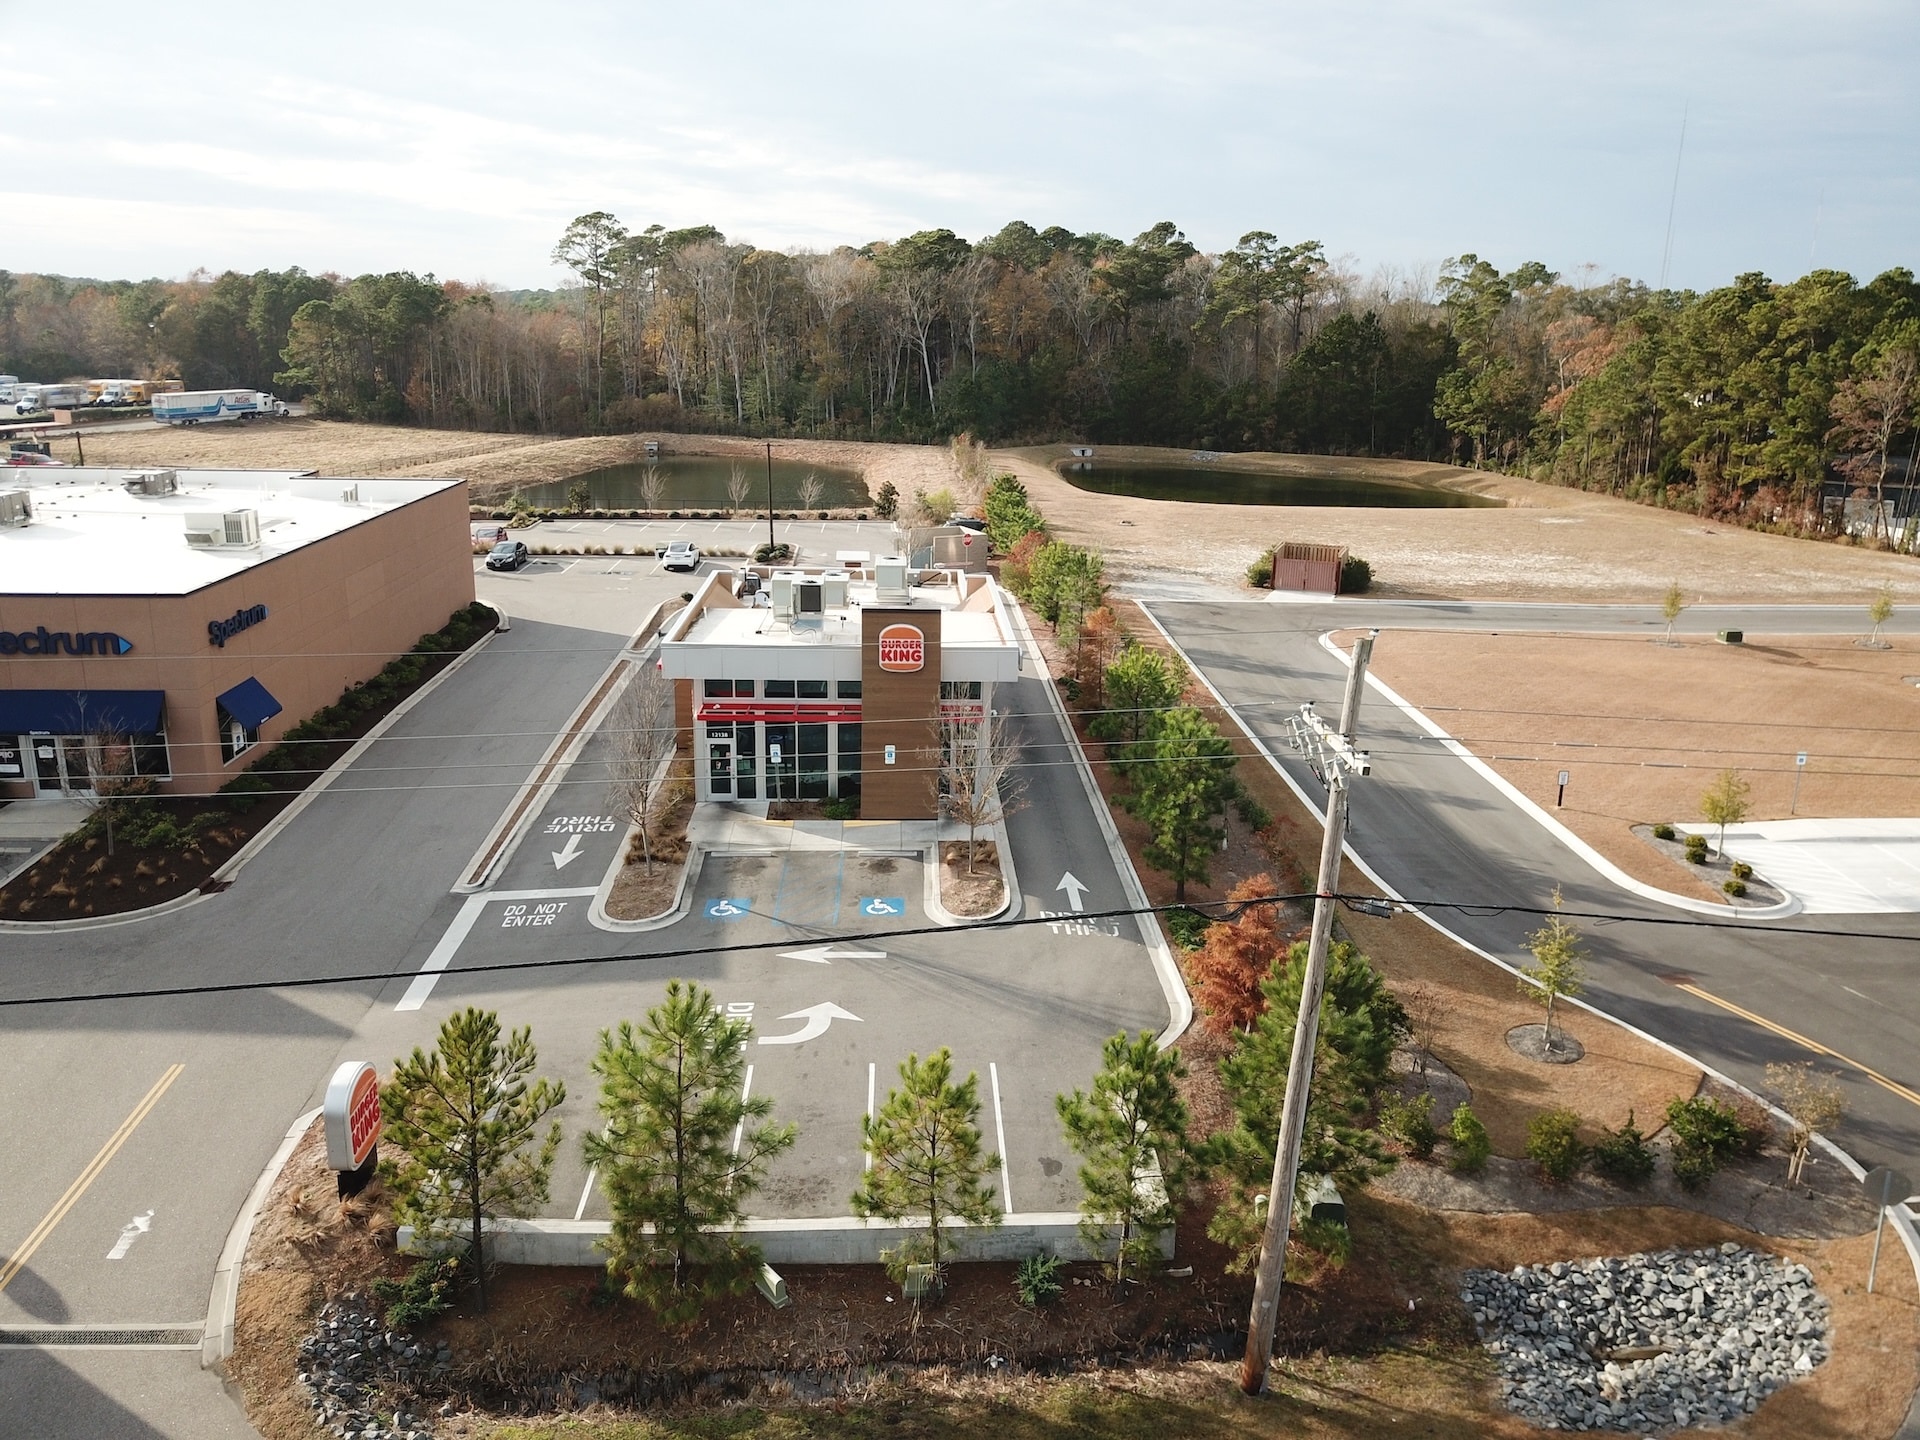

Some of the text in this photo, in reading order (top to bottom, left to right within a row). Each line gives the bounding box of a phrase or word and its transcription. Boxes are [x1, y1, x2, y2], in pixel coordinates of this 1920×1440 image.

[208, 604, 266, 648] Spectrum
[881, 640, 922, 649] BURGER
[881, 649, 922, 662] KING
[552, 815, 614, 825] THRU
[543, 823, 616, 834] DRIVE
[503, 902, 568, 916] DO NOT
[501, 914, 556, 928] ENTER
[1046, 922, 1120, 937] THRU
[350, 1082, 378, 1133] BURGER
[352, 1098, 380, 1155] KING
